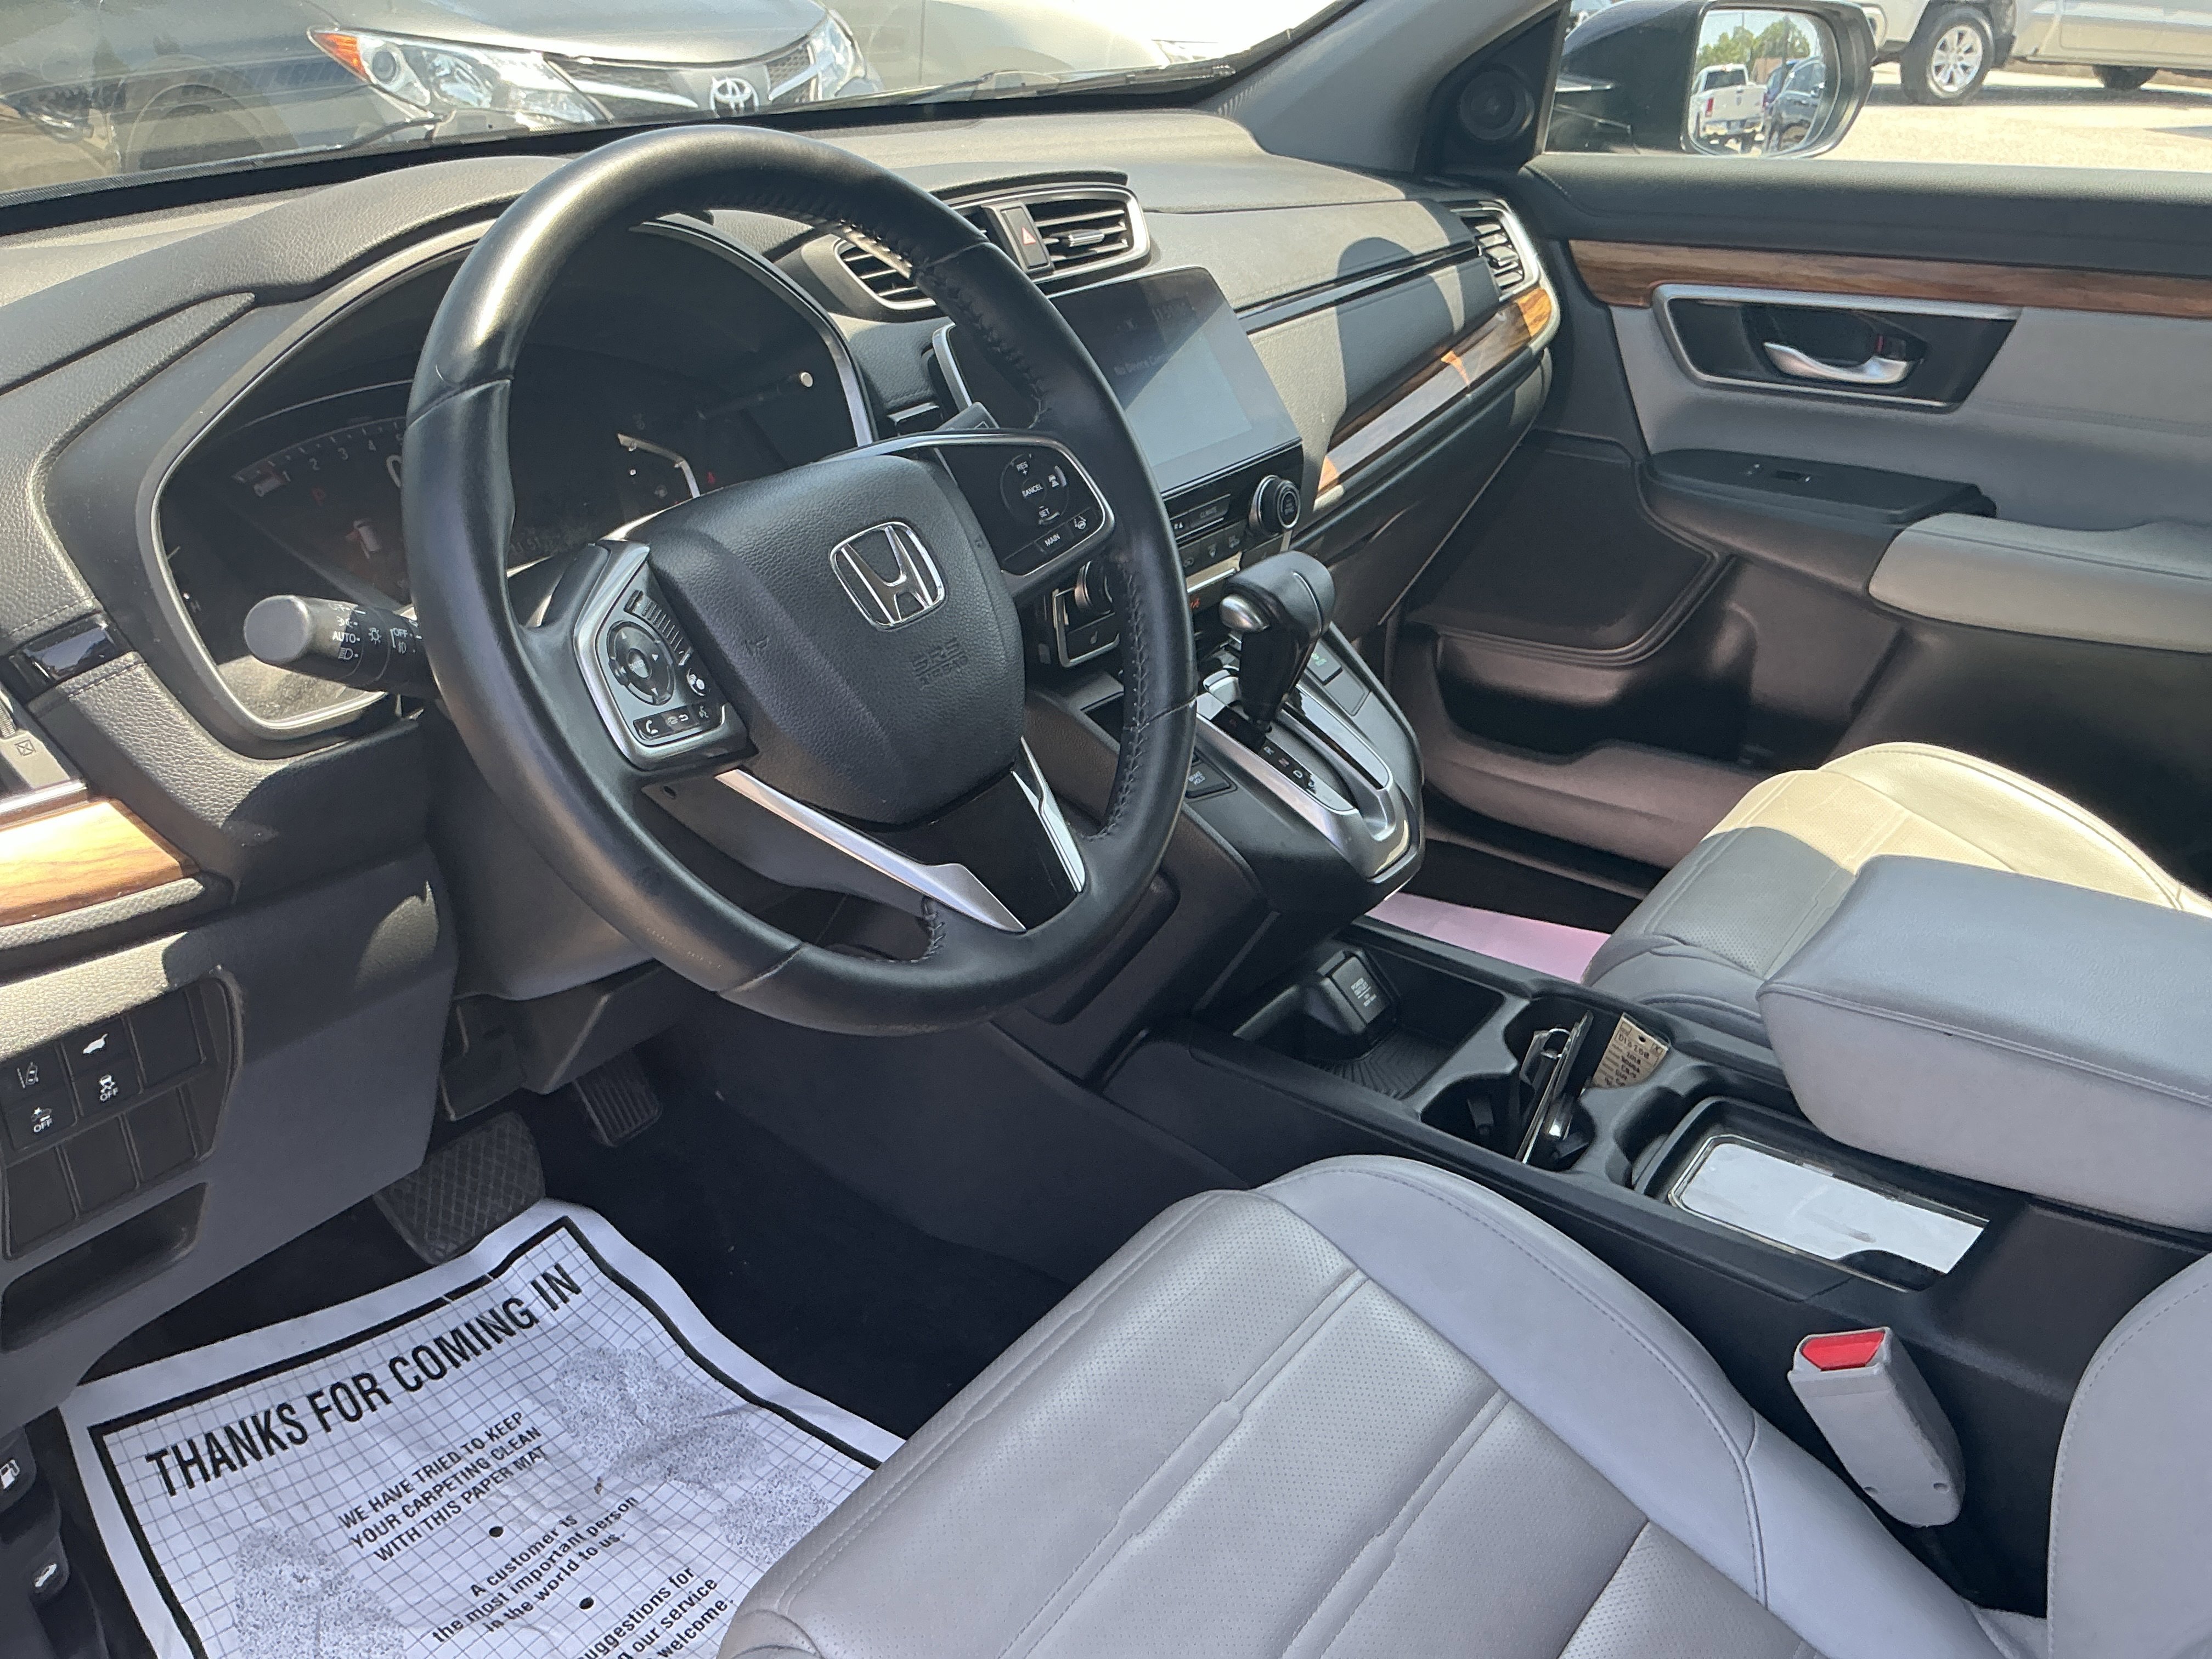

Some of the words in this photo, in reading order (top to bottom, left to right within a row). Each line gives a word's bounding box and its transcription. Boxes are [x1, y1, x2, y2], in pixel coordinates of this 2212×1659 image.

[332, 630, 356, 643] AUTO
[393, 627, 408, 638] OFF
[1293, 770, 1303, 779] D
[33, 1118, 53, 1133] OFF
[100, 1087, 119, 1102] OFF
[145, 1403, 308, 1497] THANKS
[307, 1373, 392, 1432] FOR
[390, 1297, 540, 1393] COMING
[531, 1262, 583, 1311] IN
[338, 1505, 369, 1529] WE
[369, 1478, 415, 1513] HAVE
[413, 1451, 461, 1483] TRIED
[461, 1437, 485, 1455] TO
[485, 1412, 523, 1442] KEEP
[351, 1514, 403, 1549] YOUR
[402, 1457, 491, 1518] CARPETING
[491, 1426, 542, 1460] CLEAN
[374, 1528, 422, 1562] WITH
[421, 1500, 461, 1531] THIS
[461, 1466, 514, 1504] PAPER
[512, 1446, 549, 1471] MAT
[432, 1620, 464, 1643] the
[465, 1592, 510, 1623] most
[508, 1532, 585, 1595] important
[586, 1496, 639, 1537] person
[470, 1584, 486, 1597] A
[487, 1528, 559, 1585] customer
[558, 1514, 578, 1528] is
[482, 1619, 504, 1632] in
[504, 1601, 534, 1620] the
[534, 1559, 580, 1601] world
[578, 1546, 598, 1561] to
[578, 1587, 671, 1659] uggestions
[668, 1567, 695, 1588] for
[632, 1627, 661, 1652] our
[661, 1578, 718, 1629] service
[657, 1599, 734, 1658] welcome.
